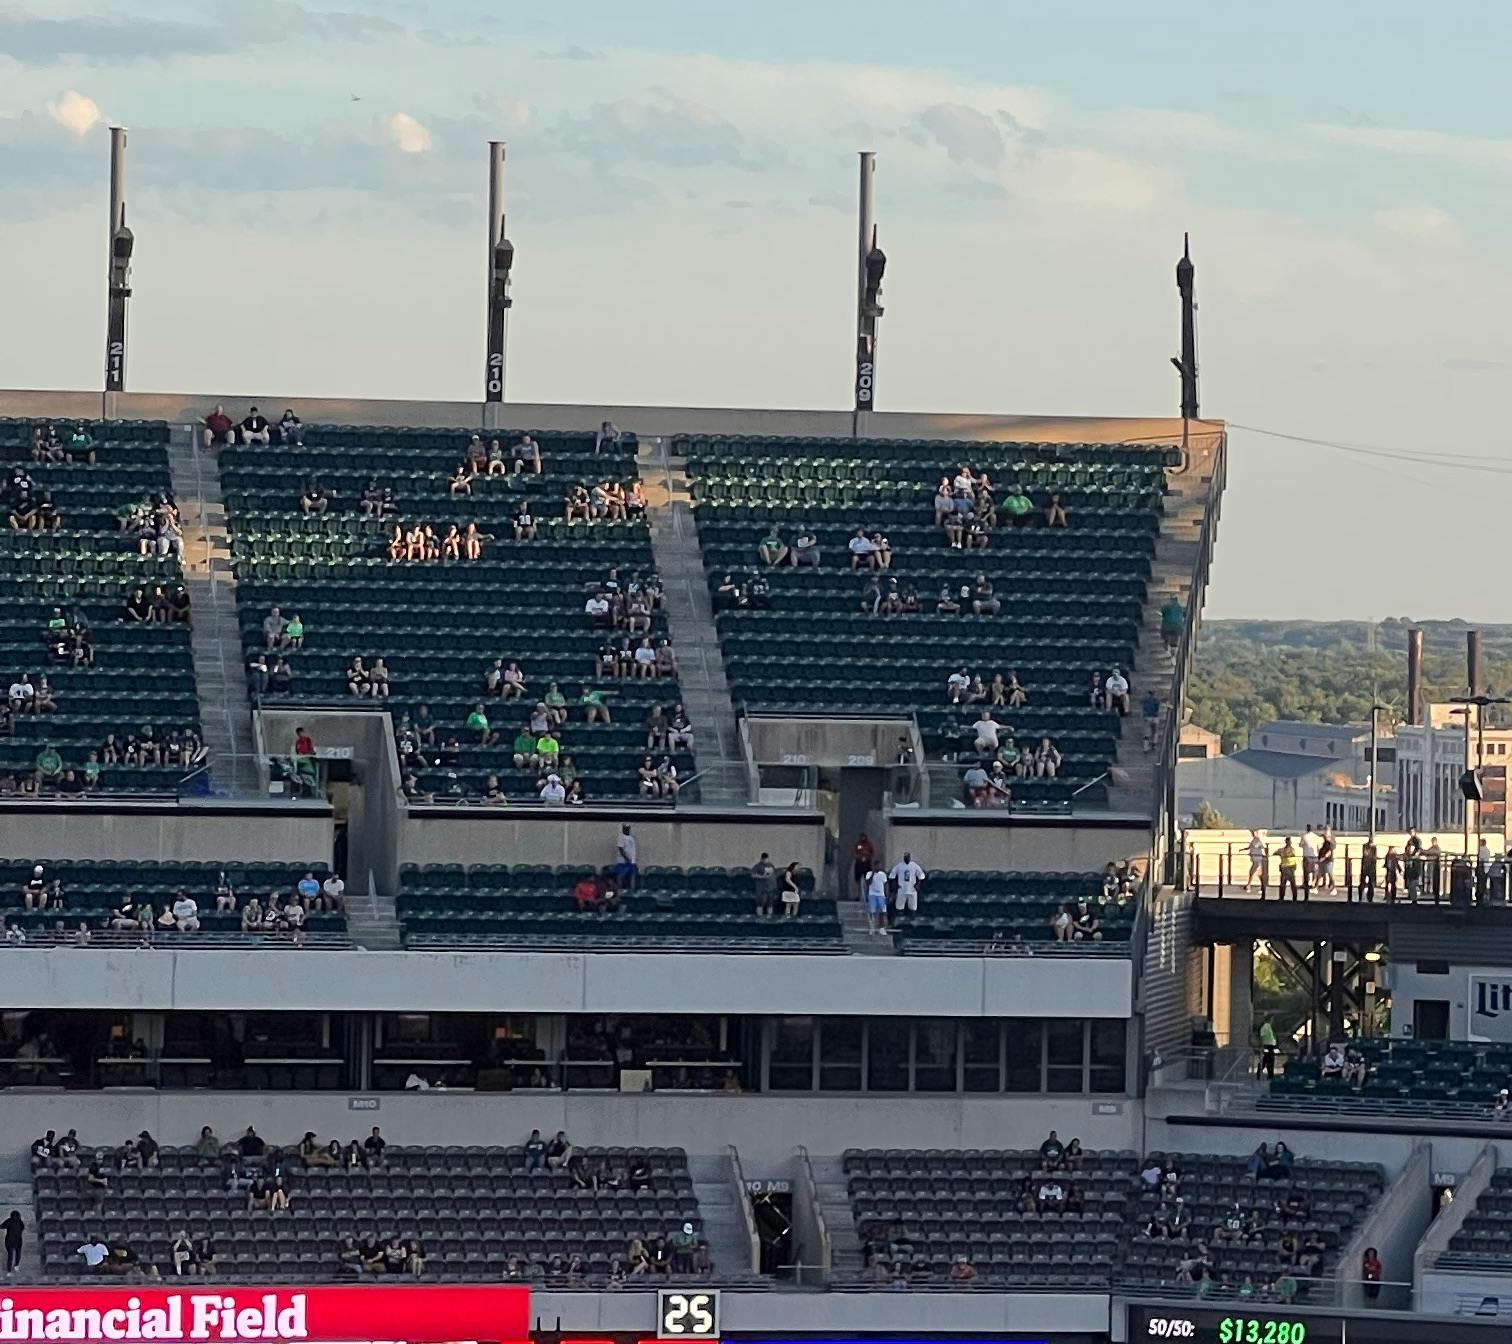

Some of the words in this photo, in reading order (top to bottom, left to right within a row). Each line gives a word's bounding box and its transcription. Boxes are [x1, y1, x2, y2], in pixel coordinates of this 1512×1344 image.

[110, 341, 125, 383] 211
[490, 351, 504, 394] 210
[858, 361, 874, 403] 209
[325, 746, 351, 759] 210
[746, 1179, 763, 1192] 10
[0, 1294, 183, 1340] inancial
[190, 1294, 308, 1340] Field
[663, 1294, 712, 1334] 25
[1148, 1318, 1196, 1338] 50/50:
